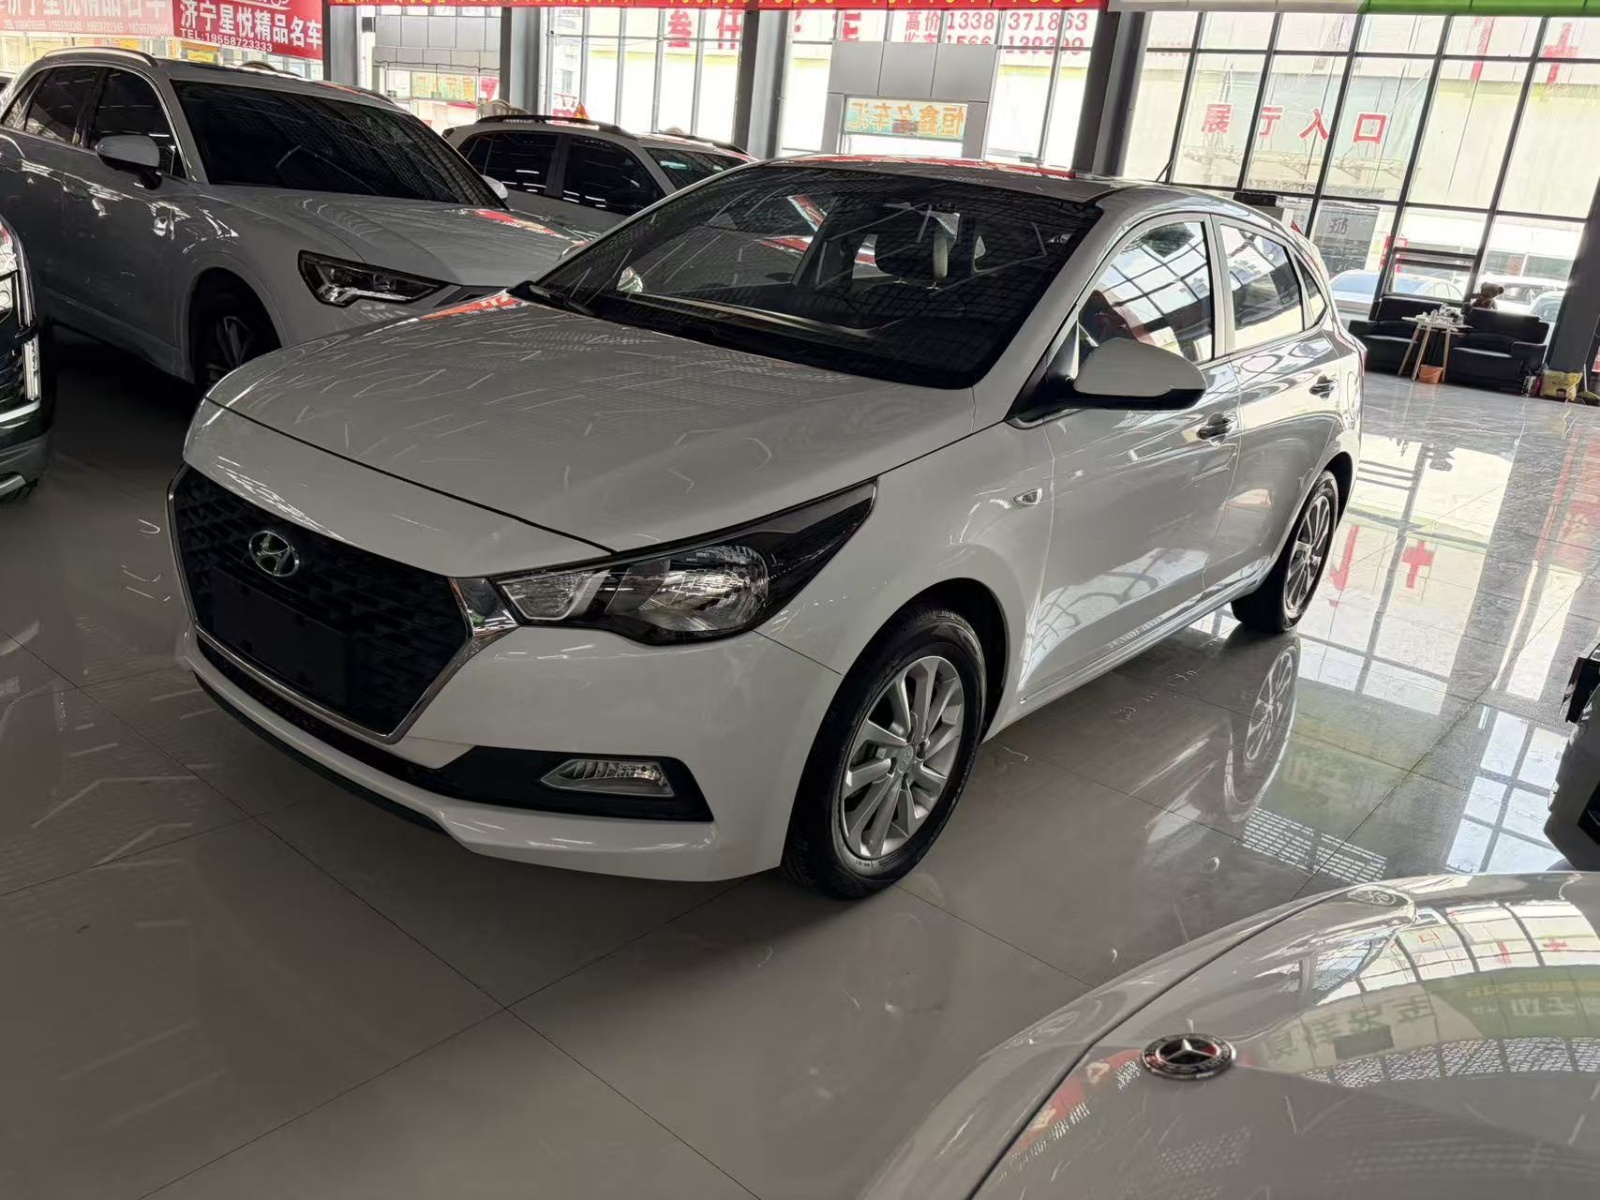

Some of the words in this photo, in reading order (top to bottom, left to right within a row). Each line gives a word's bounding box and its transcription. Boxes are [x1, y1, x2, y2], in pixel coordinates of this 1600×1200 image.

[179, 0, 322, 50] 济宁星悦精品名车
